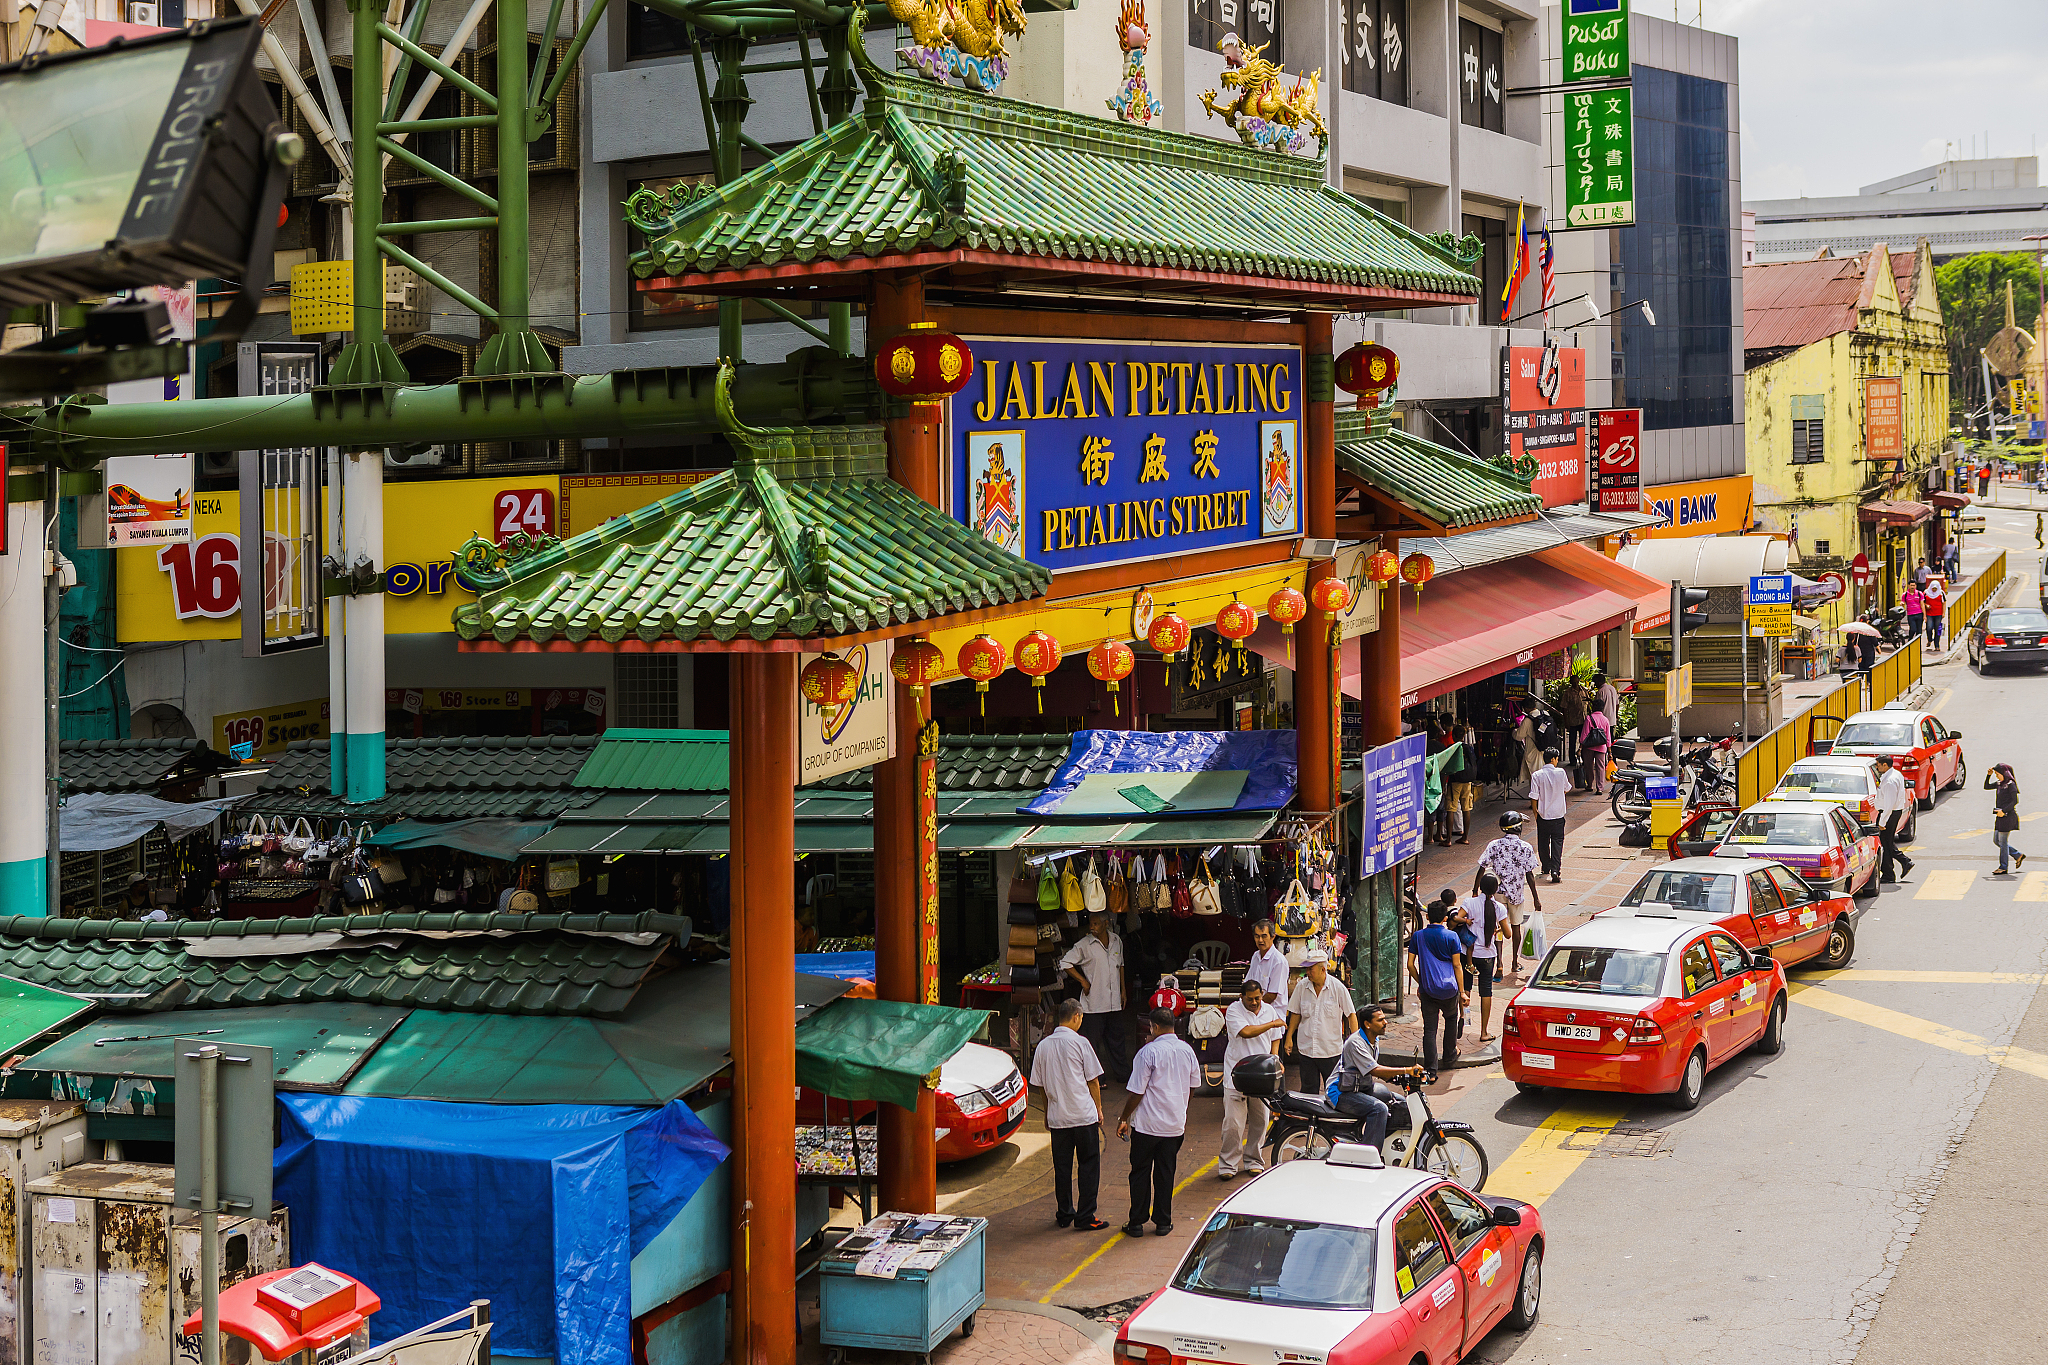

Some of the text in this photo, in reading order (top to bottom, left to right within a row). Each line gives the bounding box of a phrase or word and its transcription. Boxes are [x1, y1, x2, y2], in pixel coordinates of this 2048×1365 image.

[1463, 45, 1500, 104] 中心
[134, 59, 225, 219] PROLITE
[1604, 97, 1623, 192] 文殊書局
[1577, 205, 1624, 221] 入口處
[977, 360, 1291, 422] JALAN PETALING
[2015, 383, 2024, 410] Nikon
[1870, 398, 1897, 408] SHIN KEE
[1870, 416, 1898, 425] SPECIALIST
[1559, 458, 1578, 477] 3888
[500, 493, 545, 532] 24
[1043, 498, 1165, 552] PETALING
[1169, 490, 1250, 536] STREET
[1651, 493, 1717, 531] ON BANK
[129, 527, 189, 539] SAYANGI KUALA LUMPUR
[1751, 592, 1790, 602] LORONG BAS
[1356, 614, 1375, 628] COMPANIES
[1516, 648, 1534, 665] WELCOME
[438, 690, 500, 709] 168 Store
[268, 709, 308, 722] KEDAI SERBANEKA
[268, 722, 320, 746] Store
[804, 735, 886, 771] GROUP OF COMPANIES
[1554, 1025, 1592, 1038] HWD 263
